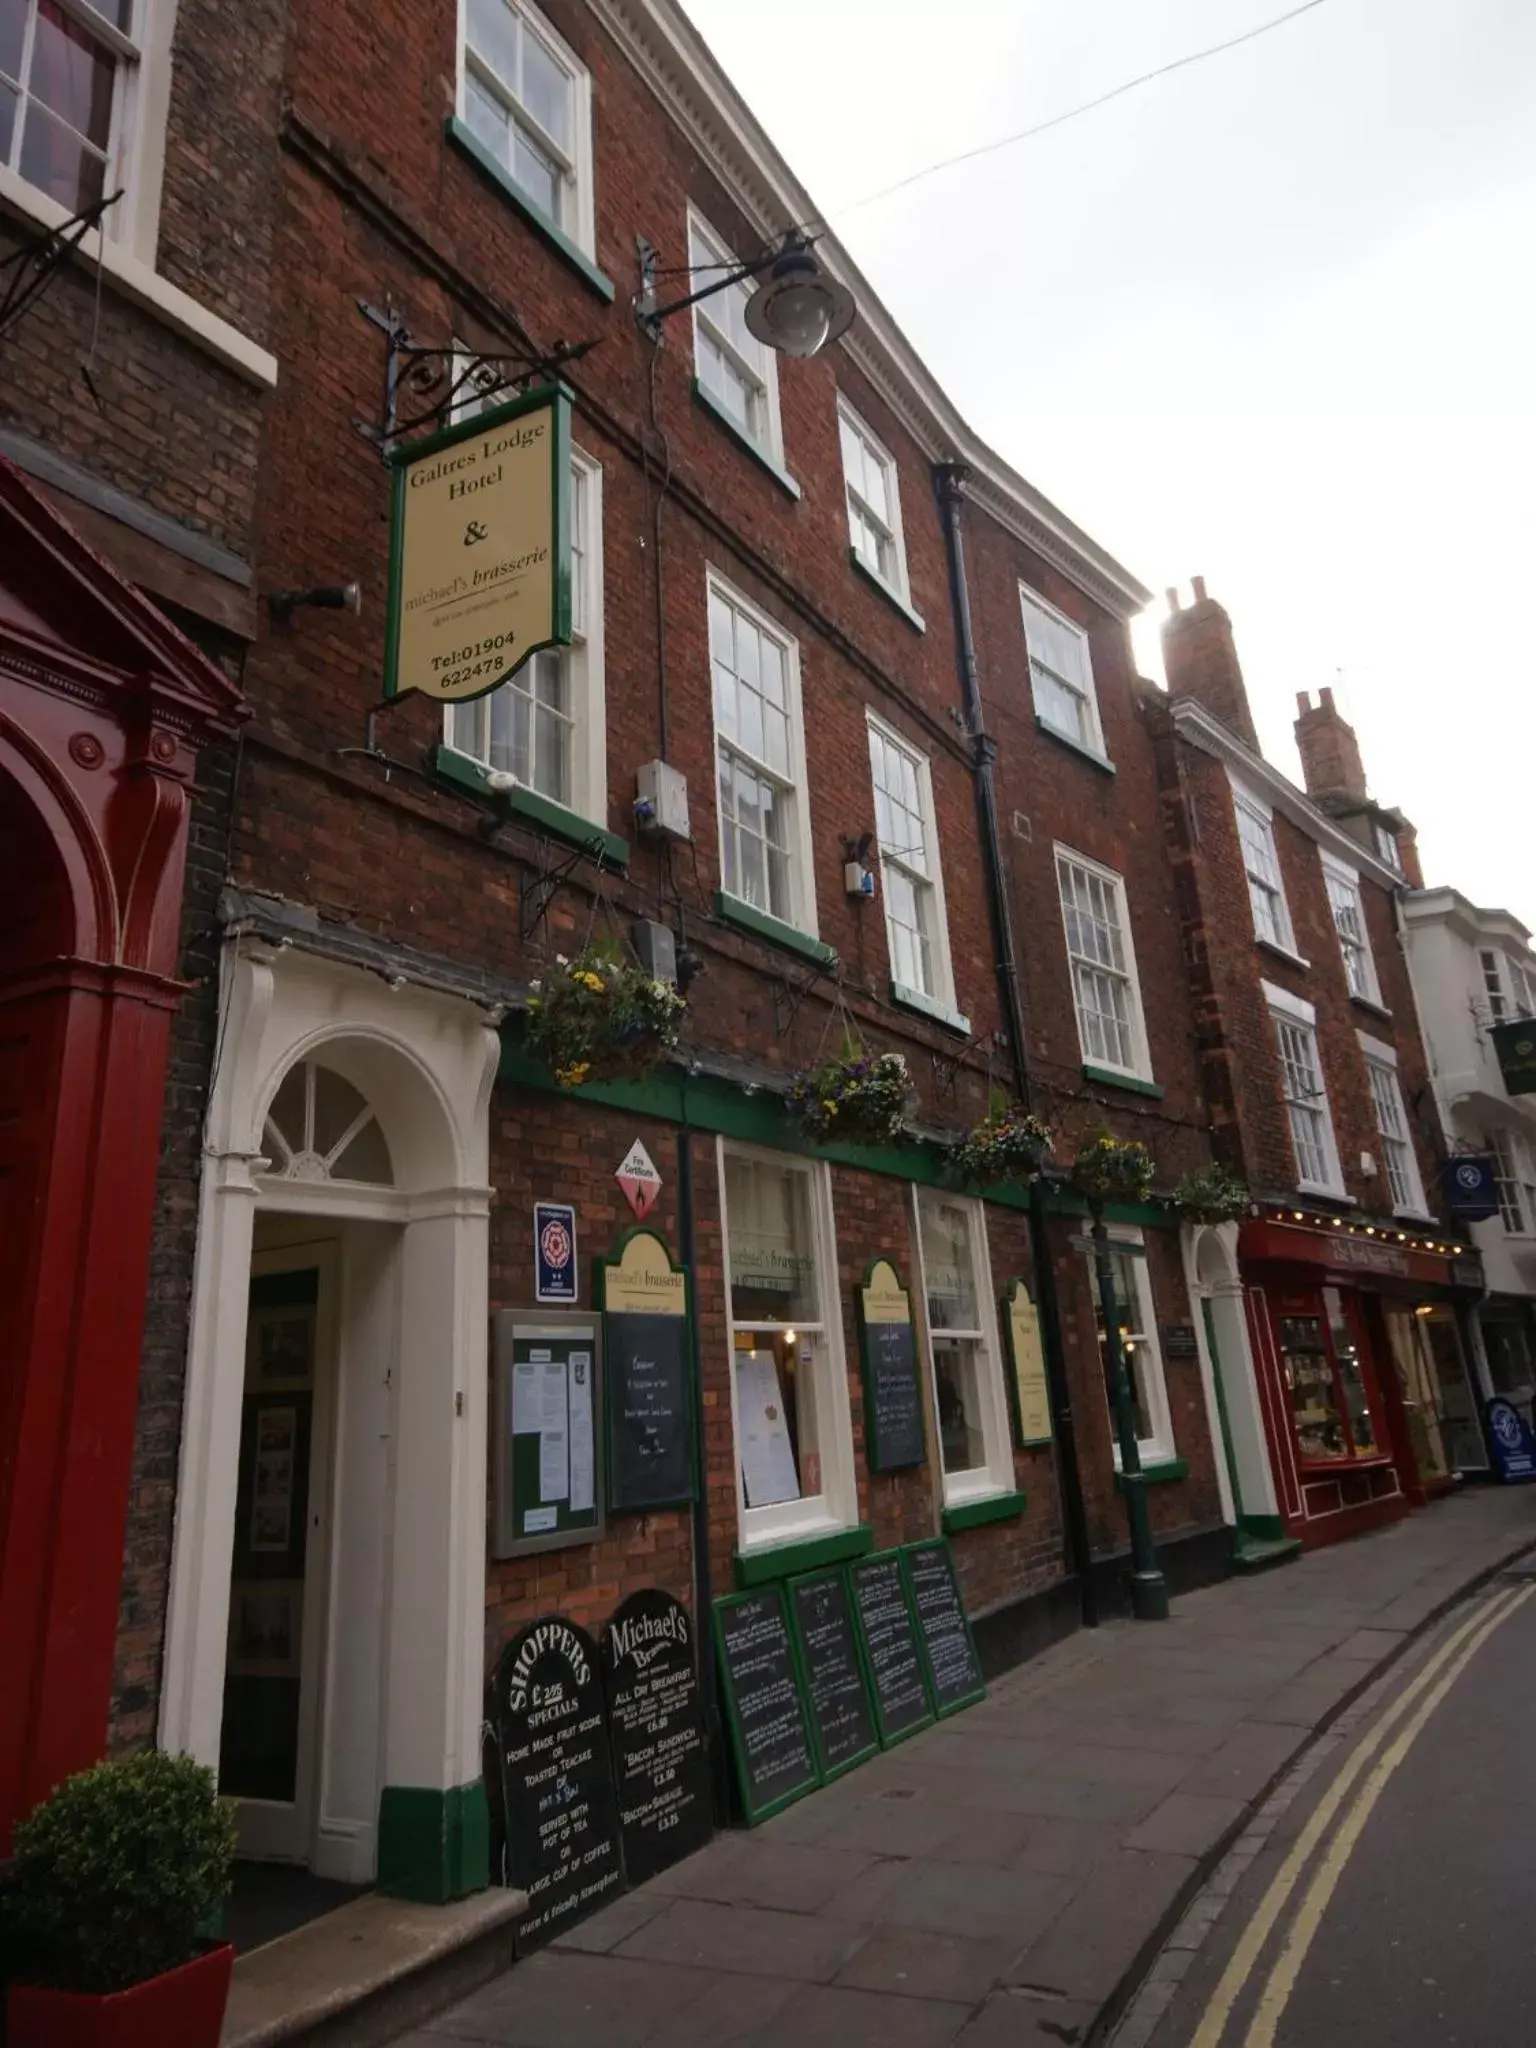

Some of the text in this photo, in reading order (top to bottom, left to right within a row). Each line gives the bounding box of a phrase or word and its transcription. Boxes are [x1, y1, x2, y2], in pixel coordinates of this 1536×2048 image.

[410, 422, 545, 489] Galtres Lodge
[448, 465, 503, 501] Hotel
[463, 520, 488, 546] &
[473, 546, 548, 587] brasserie
[431, 631, 516, 671] Tel:01904
[441, 656, 504, 688] 622478
[610, 1605, 688, 1669] Michael's
[509, 1624, 591, 1711] SHOPPERS
[527, 1697, 579, 1729] SPECIALS
